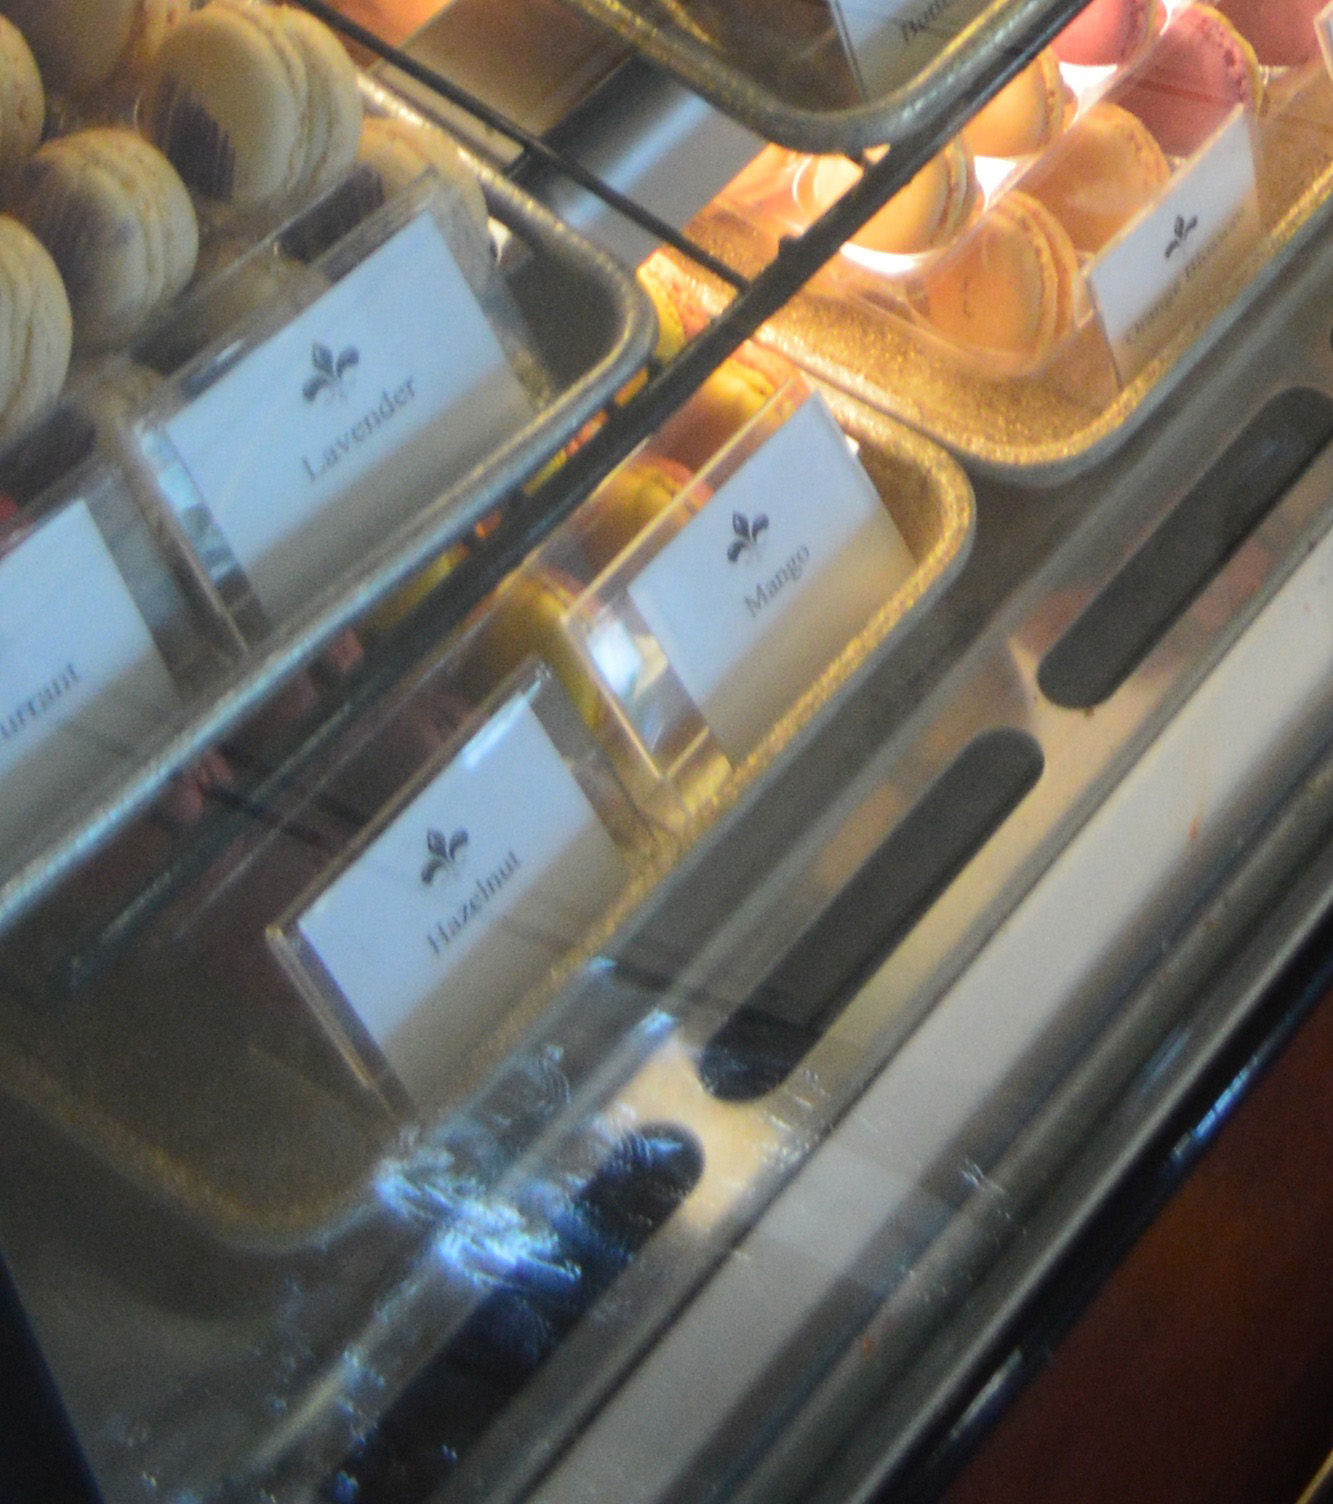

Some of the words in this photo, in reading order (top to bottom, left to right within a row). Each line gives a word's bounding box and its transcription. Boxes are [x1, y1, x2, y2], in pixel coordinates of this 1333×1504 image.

[300, 372, 418, 484] Lavender
[742, 542, 813, 620] Mango
[425, 848, 524, 959] Hazelnut
